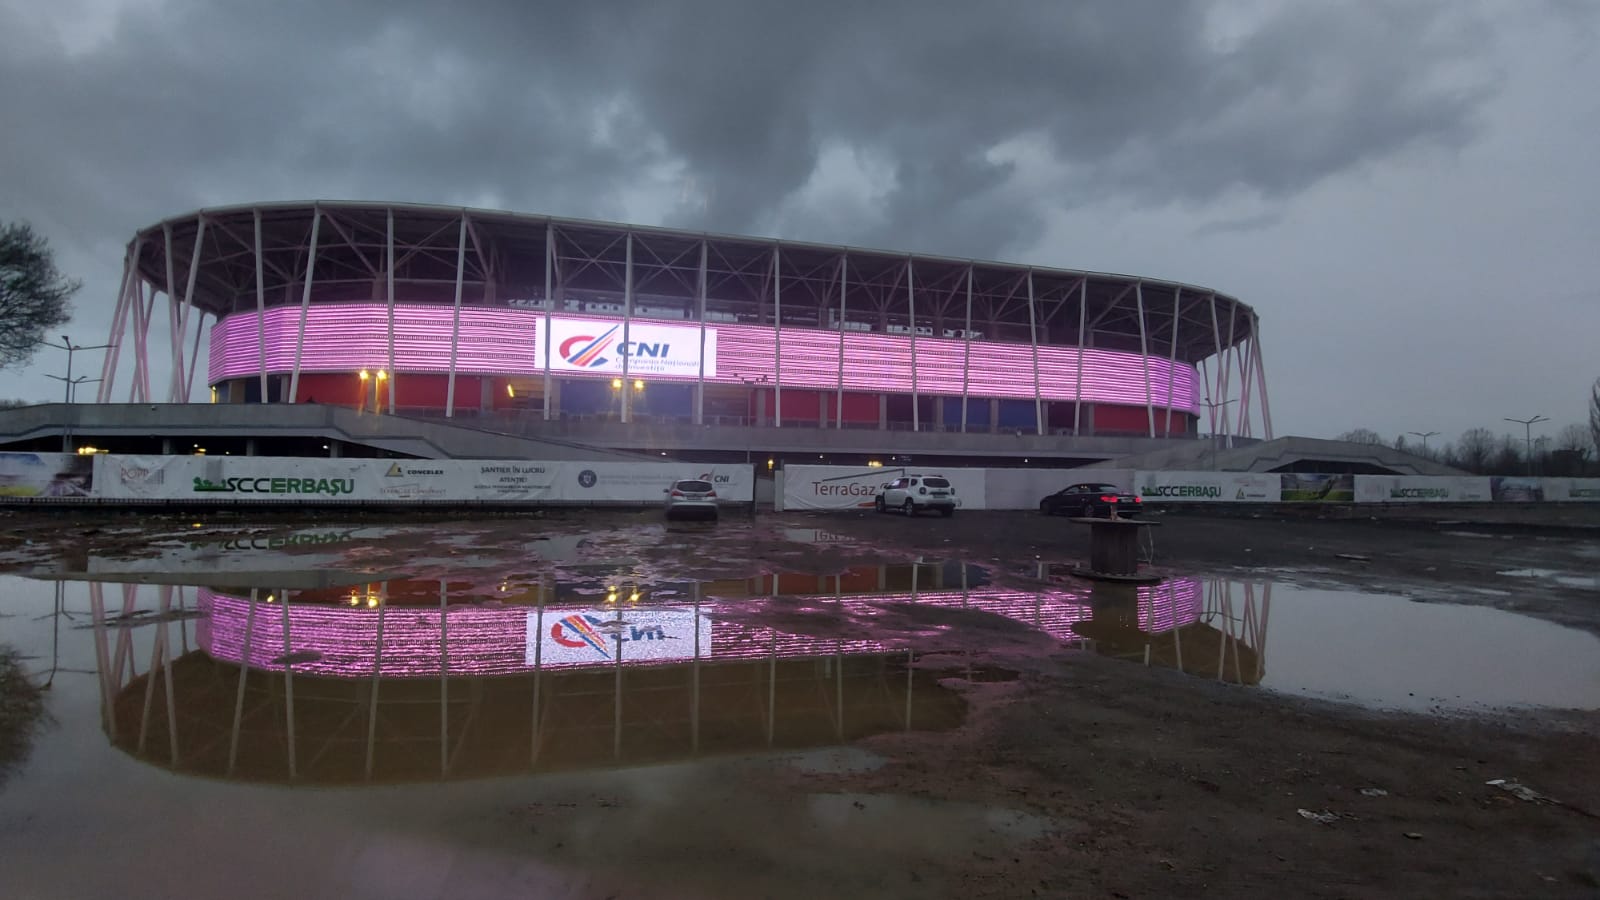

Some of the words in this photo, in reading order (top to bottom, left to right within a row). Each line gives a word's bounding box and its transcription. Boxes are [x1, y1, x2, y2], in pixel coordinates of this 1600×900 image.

[616, 341, 670, 358] CNI
[714, 475, 730, 483] CNI
[812, 481, 876, 496] TerraGaz
